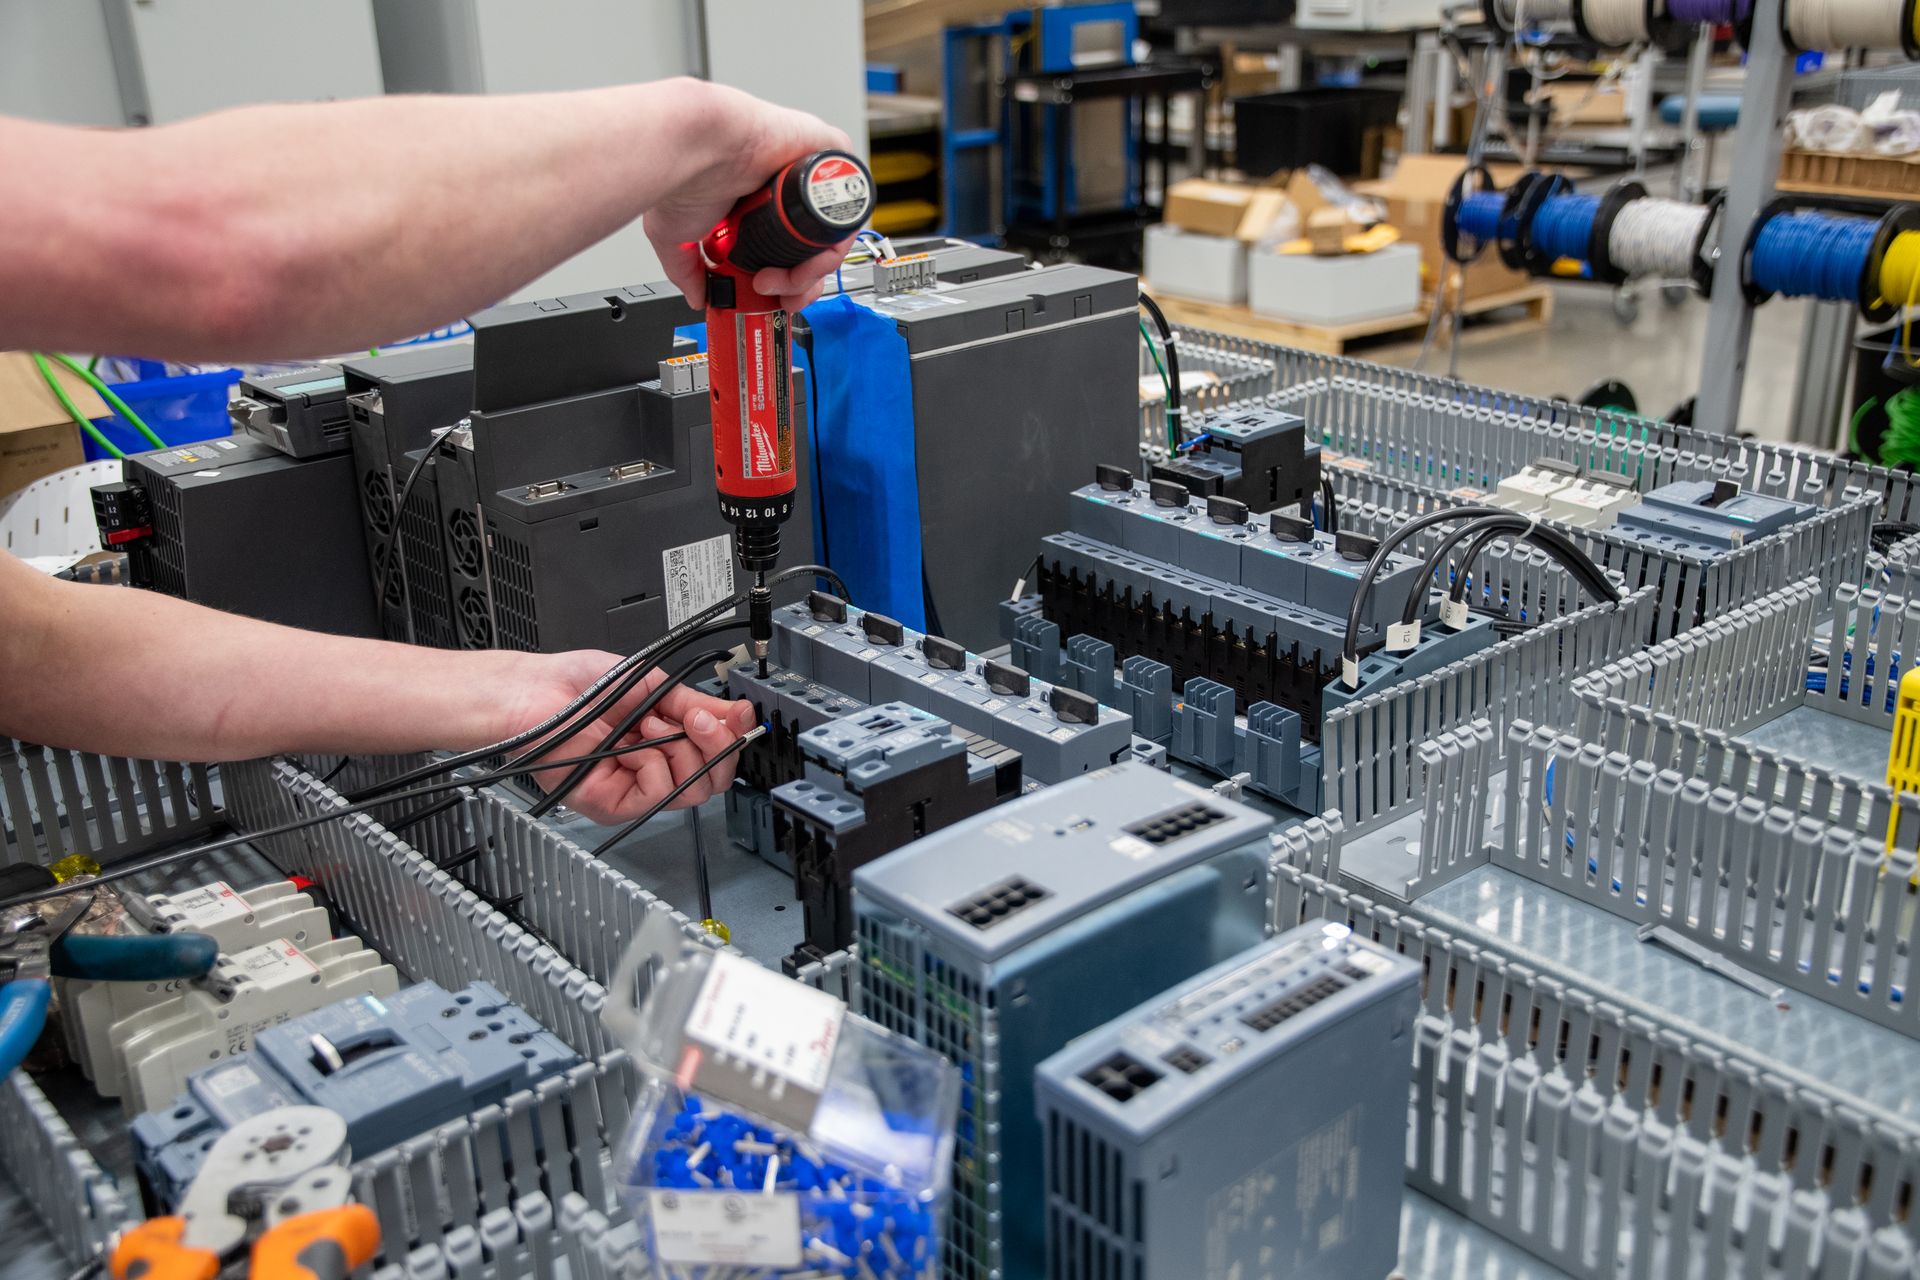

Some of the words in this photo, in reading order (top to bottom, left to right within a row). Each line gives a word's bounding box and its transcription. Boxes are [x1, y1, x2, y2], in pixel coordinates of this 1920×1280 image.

[754, 329, 765, 411] SCREWDRIVER
[752, 423, 772, 476] Milwaukee
[730, 506, 740, 517] 14
[746, 508, 758, 518] 12
[764, 508, 776, 518] 10
[782, 504, 788, 514] 8
[725, 558, 733, 592] SIEMENS
[1402, 630, 1410, 644] 1L2
